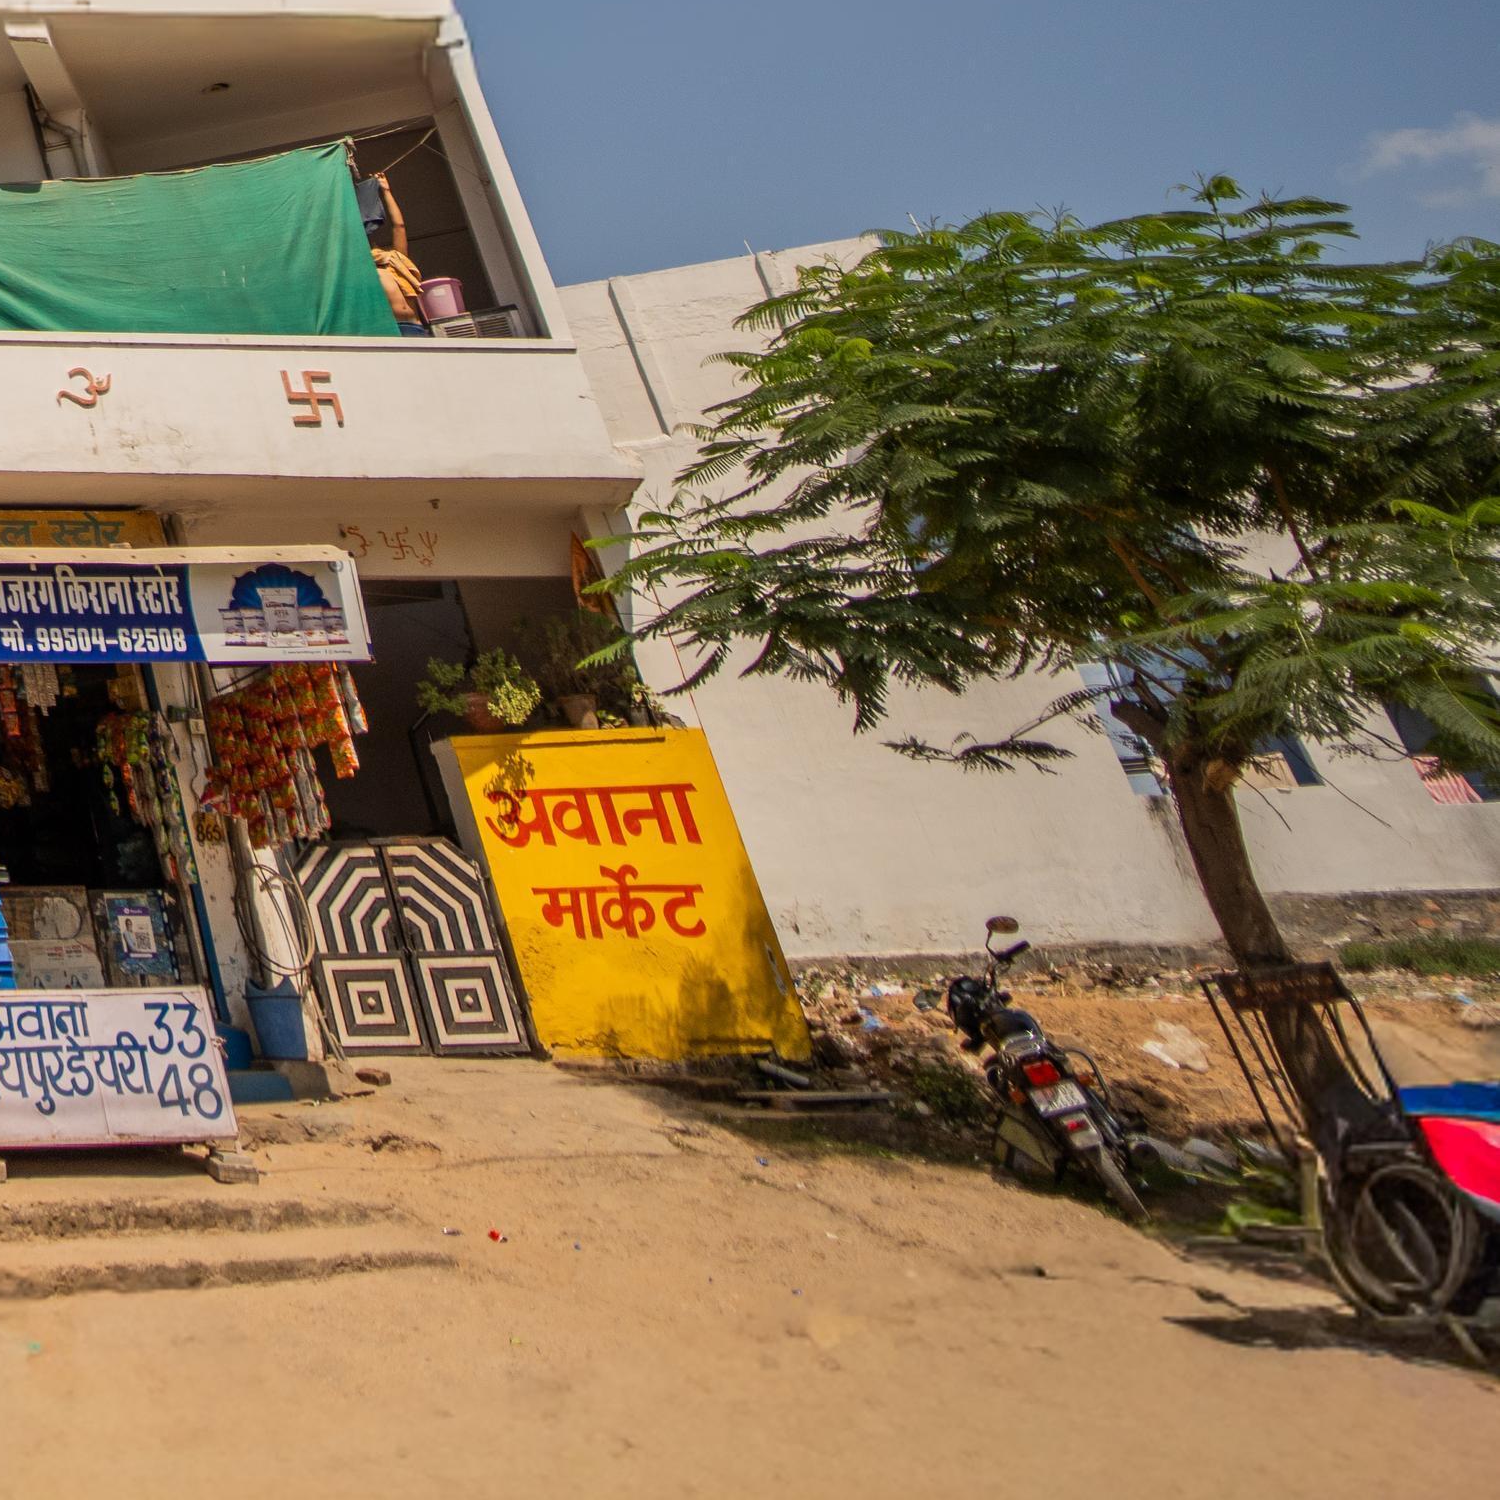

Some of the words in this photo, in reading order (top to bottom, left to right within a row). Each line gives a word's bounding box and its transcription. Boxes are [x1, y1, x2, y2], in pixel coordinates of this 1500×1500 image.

[48, 510, 126, 547] स्टोर
[55, 565, 132, 615] किराना
[133, 565, 184, 615] स्टोर
[36, 627, 188, 653] 99504-62508
[485, 783, 703, 849] अवाना
[531, 864, 707, 940] मार्केट
[144, 1002, 207, 1059] 33
[157, 1062, 223, 1120] 48
